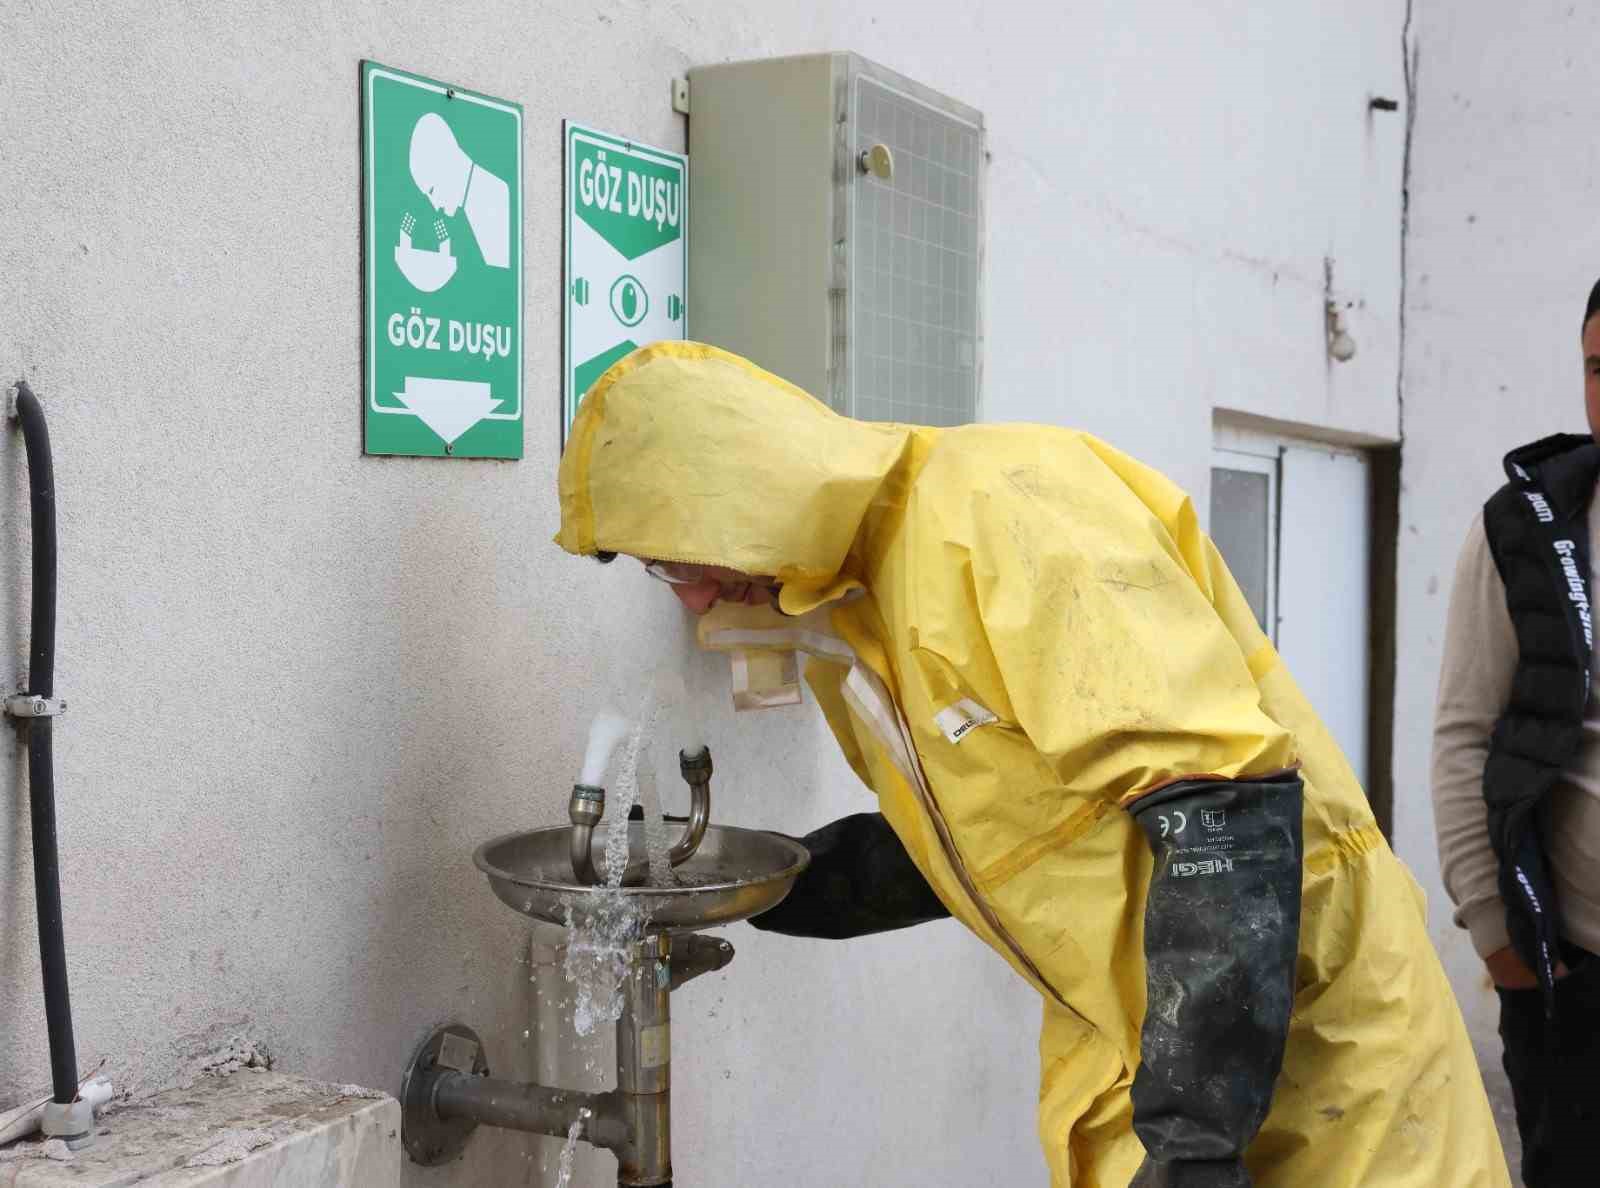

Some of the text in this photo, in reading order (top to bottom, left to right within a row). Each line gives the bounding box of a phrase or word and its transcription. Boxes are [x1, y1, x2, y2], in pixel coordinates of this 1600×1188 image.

[580, 150, 679, 233] GÖZ DUŞU
[388, 306, 511, 361] GÖZ DUŞU
[1171, 857, 1233, 877] HEGI
